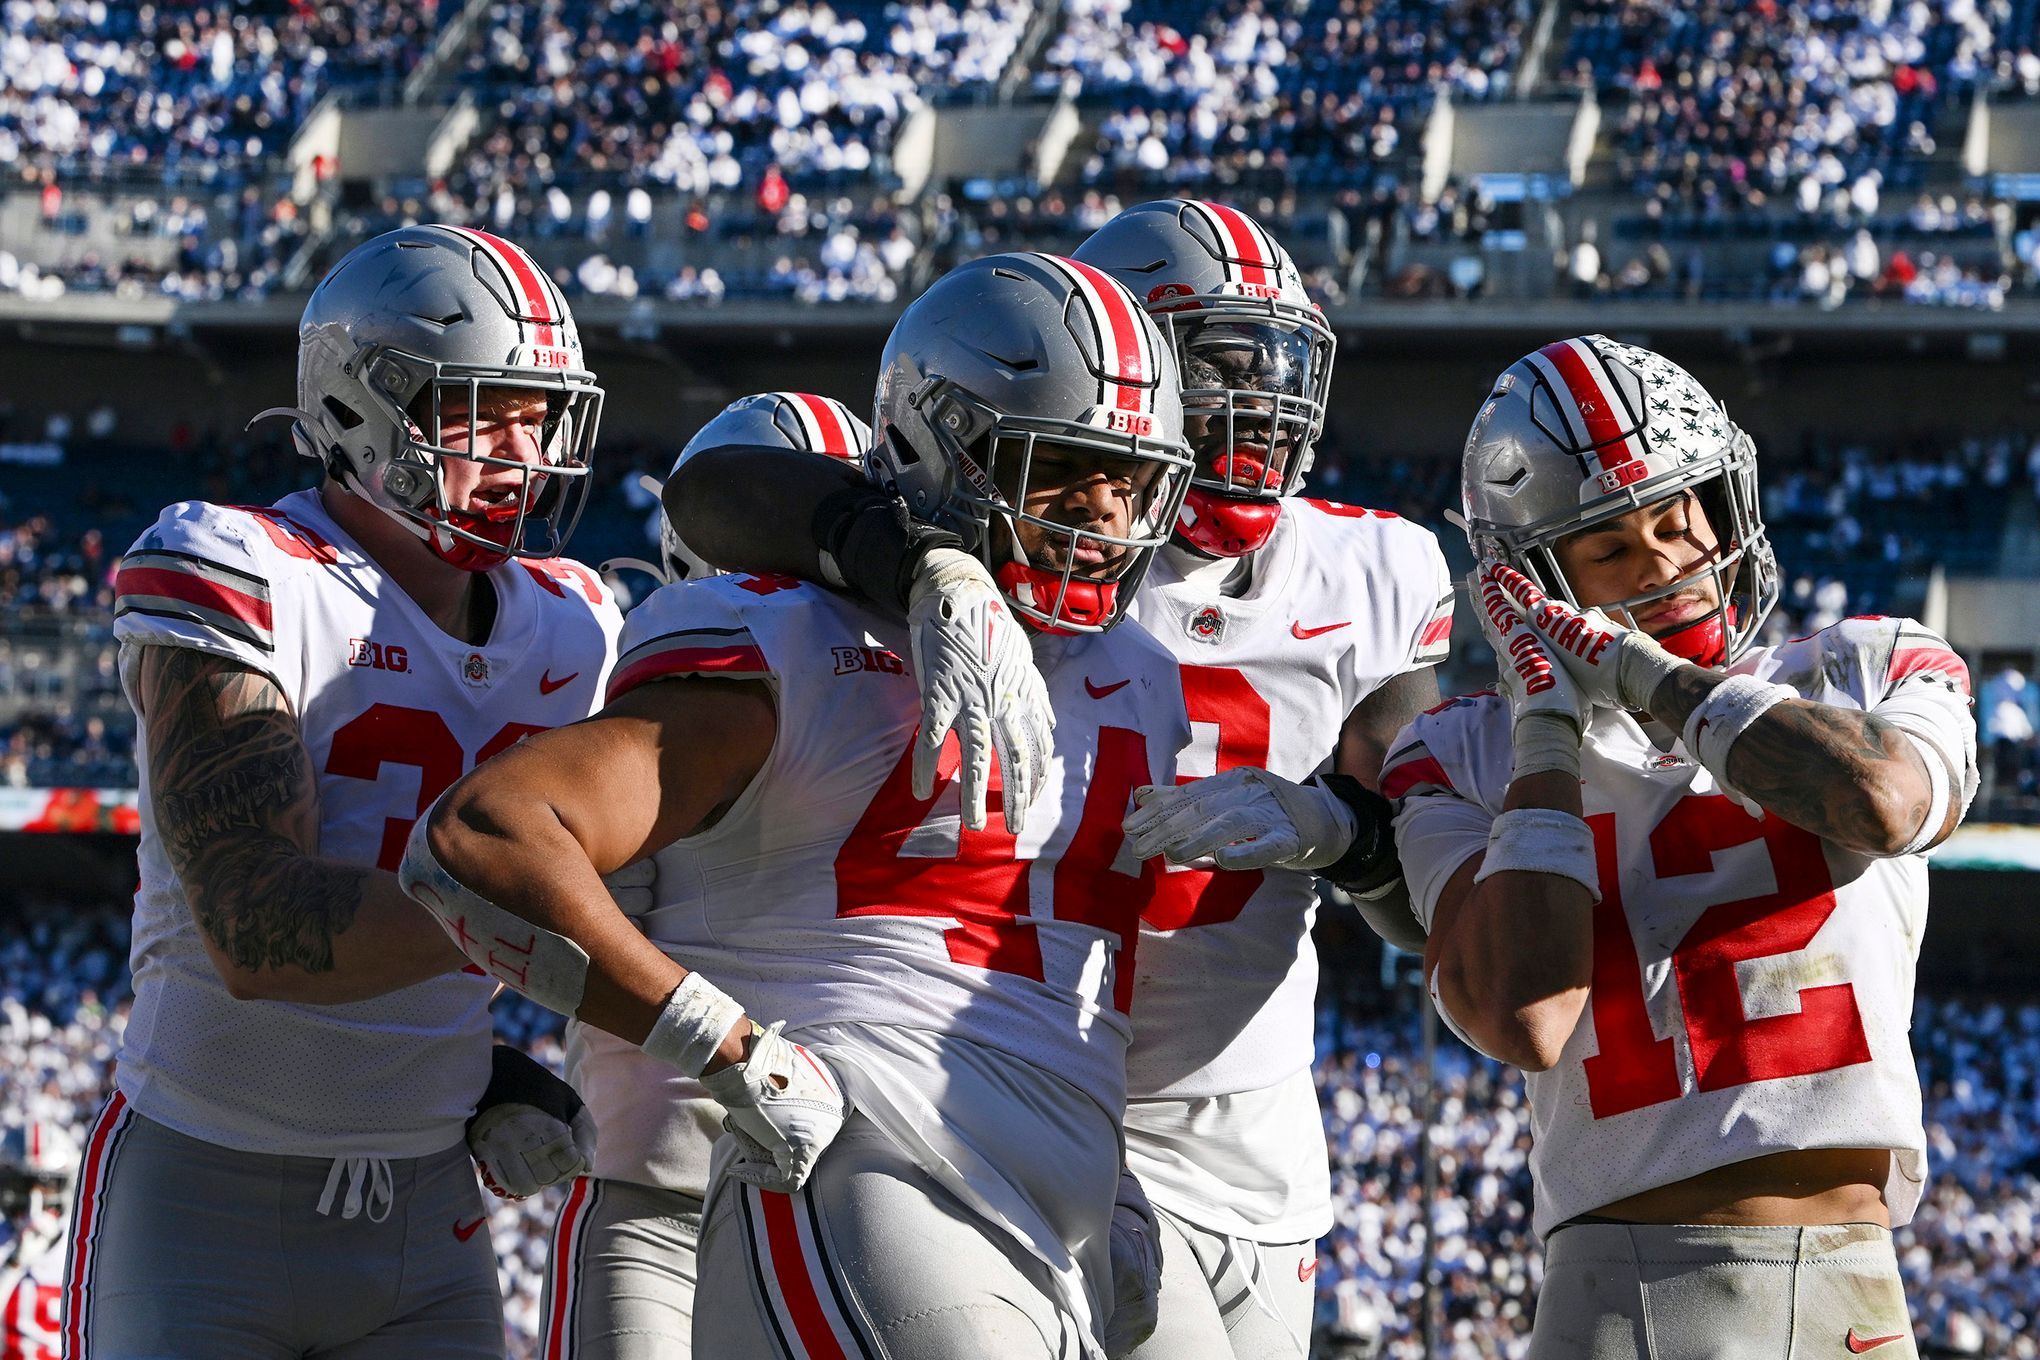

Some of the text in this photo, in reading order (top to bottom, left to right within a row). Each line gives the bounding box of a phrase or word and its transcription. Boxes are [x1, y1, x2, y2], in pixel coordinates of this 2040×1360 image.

[1536, 604, 1615, 667] STATE
[834, 724, 1158, 1017] 44
[1583, 795, 1872, 1120] 12
